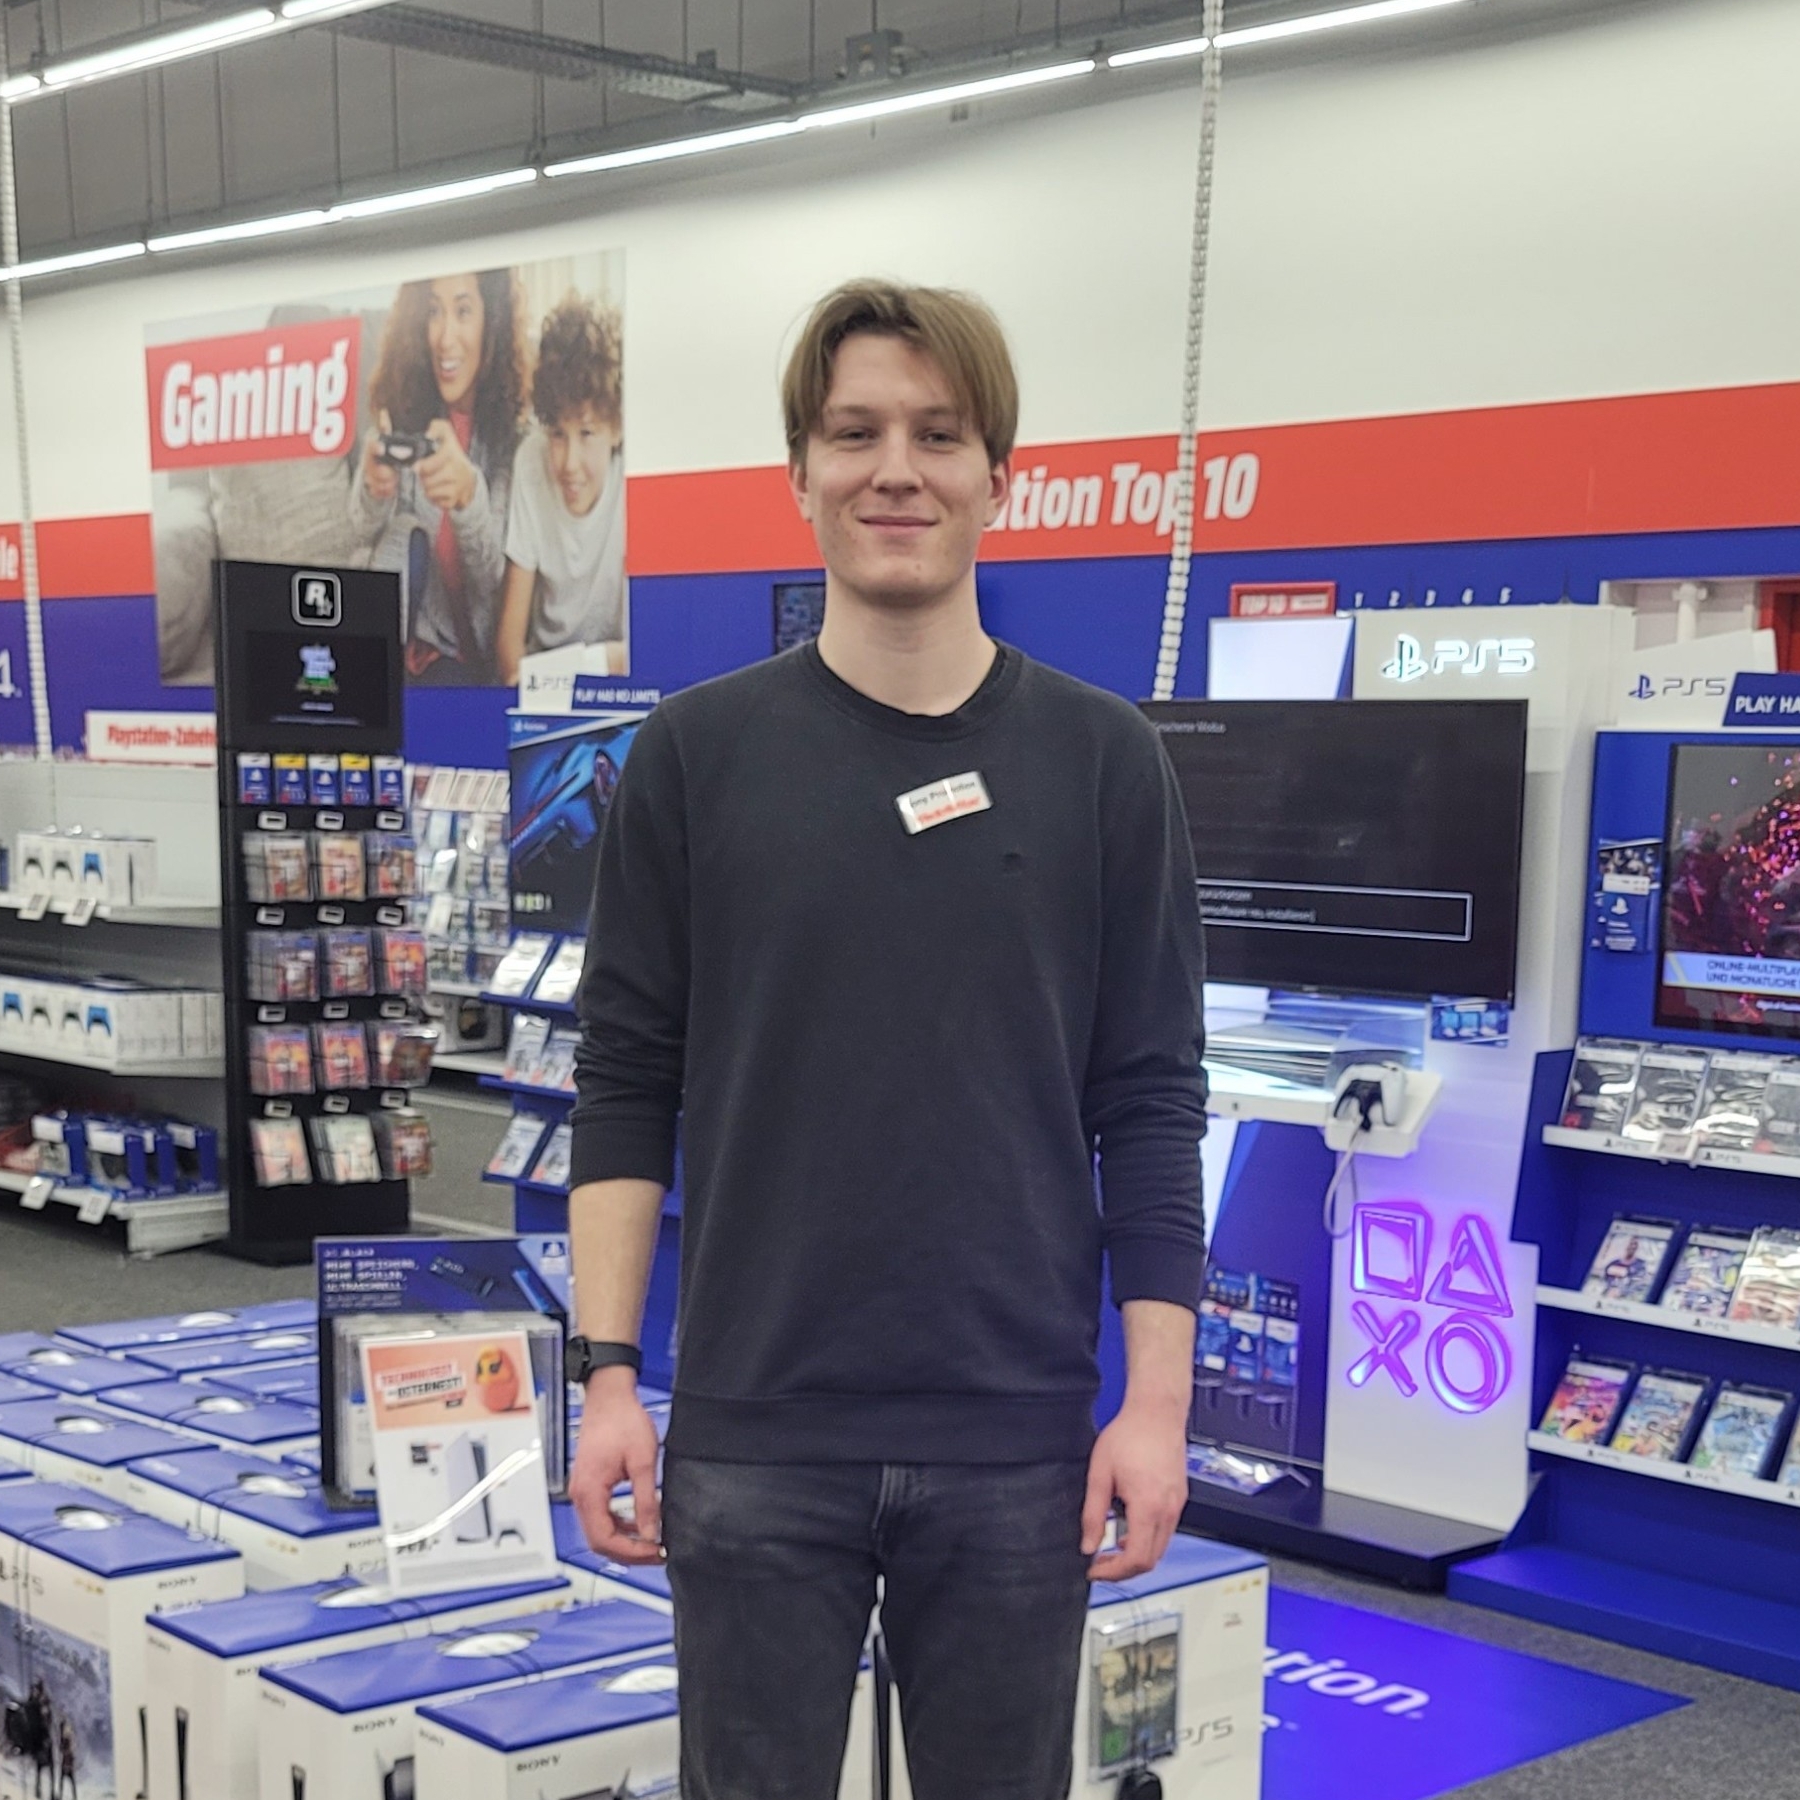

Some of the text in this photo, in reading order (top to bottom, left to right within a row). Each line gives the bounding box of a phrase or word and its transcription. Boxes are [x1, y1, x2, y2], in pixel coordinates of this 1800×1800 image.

[160, 337, 350, 453] Gaming
[1110, 462, 1189, 537] Top
[1202, 452, 1261, 521] 10
[1433, 637, 1537, 675] PS5
[1662, 677, 1727, 697] PS5
[1735, 695, 1776, 714] PLAY
